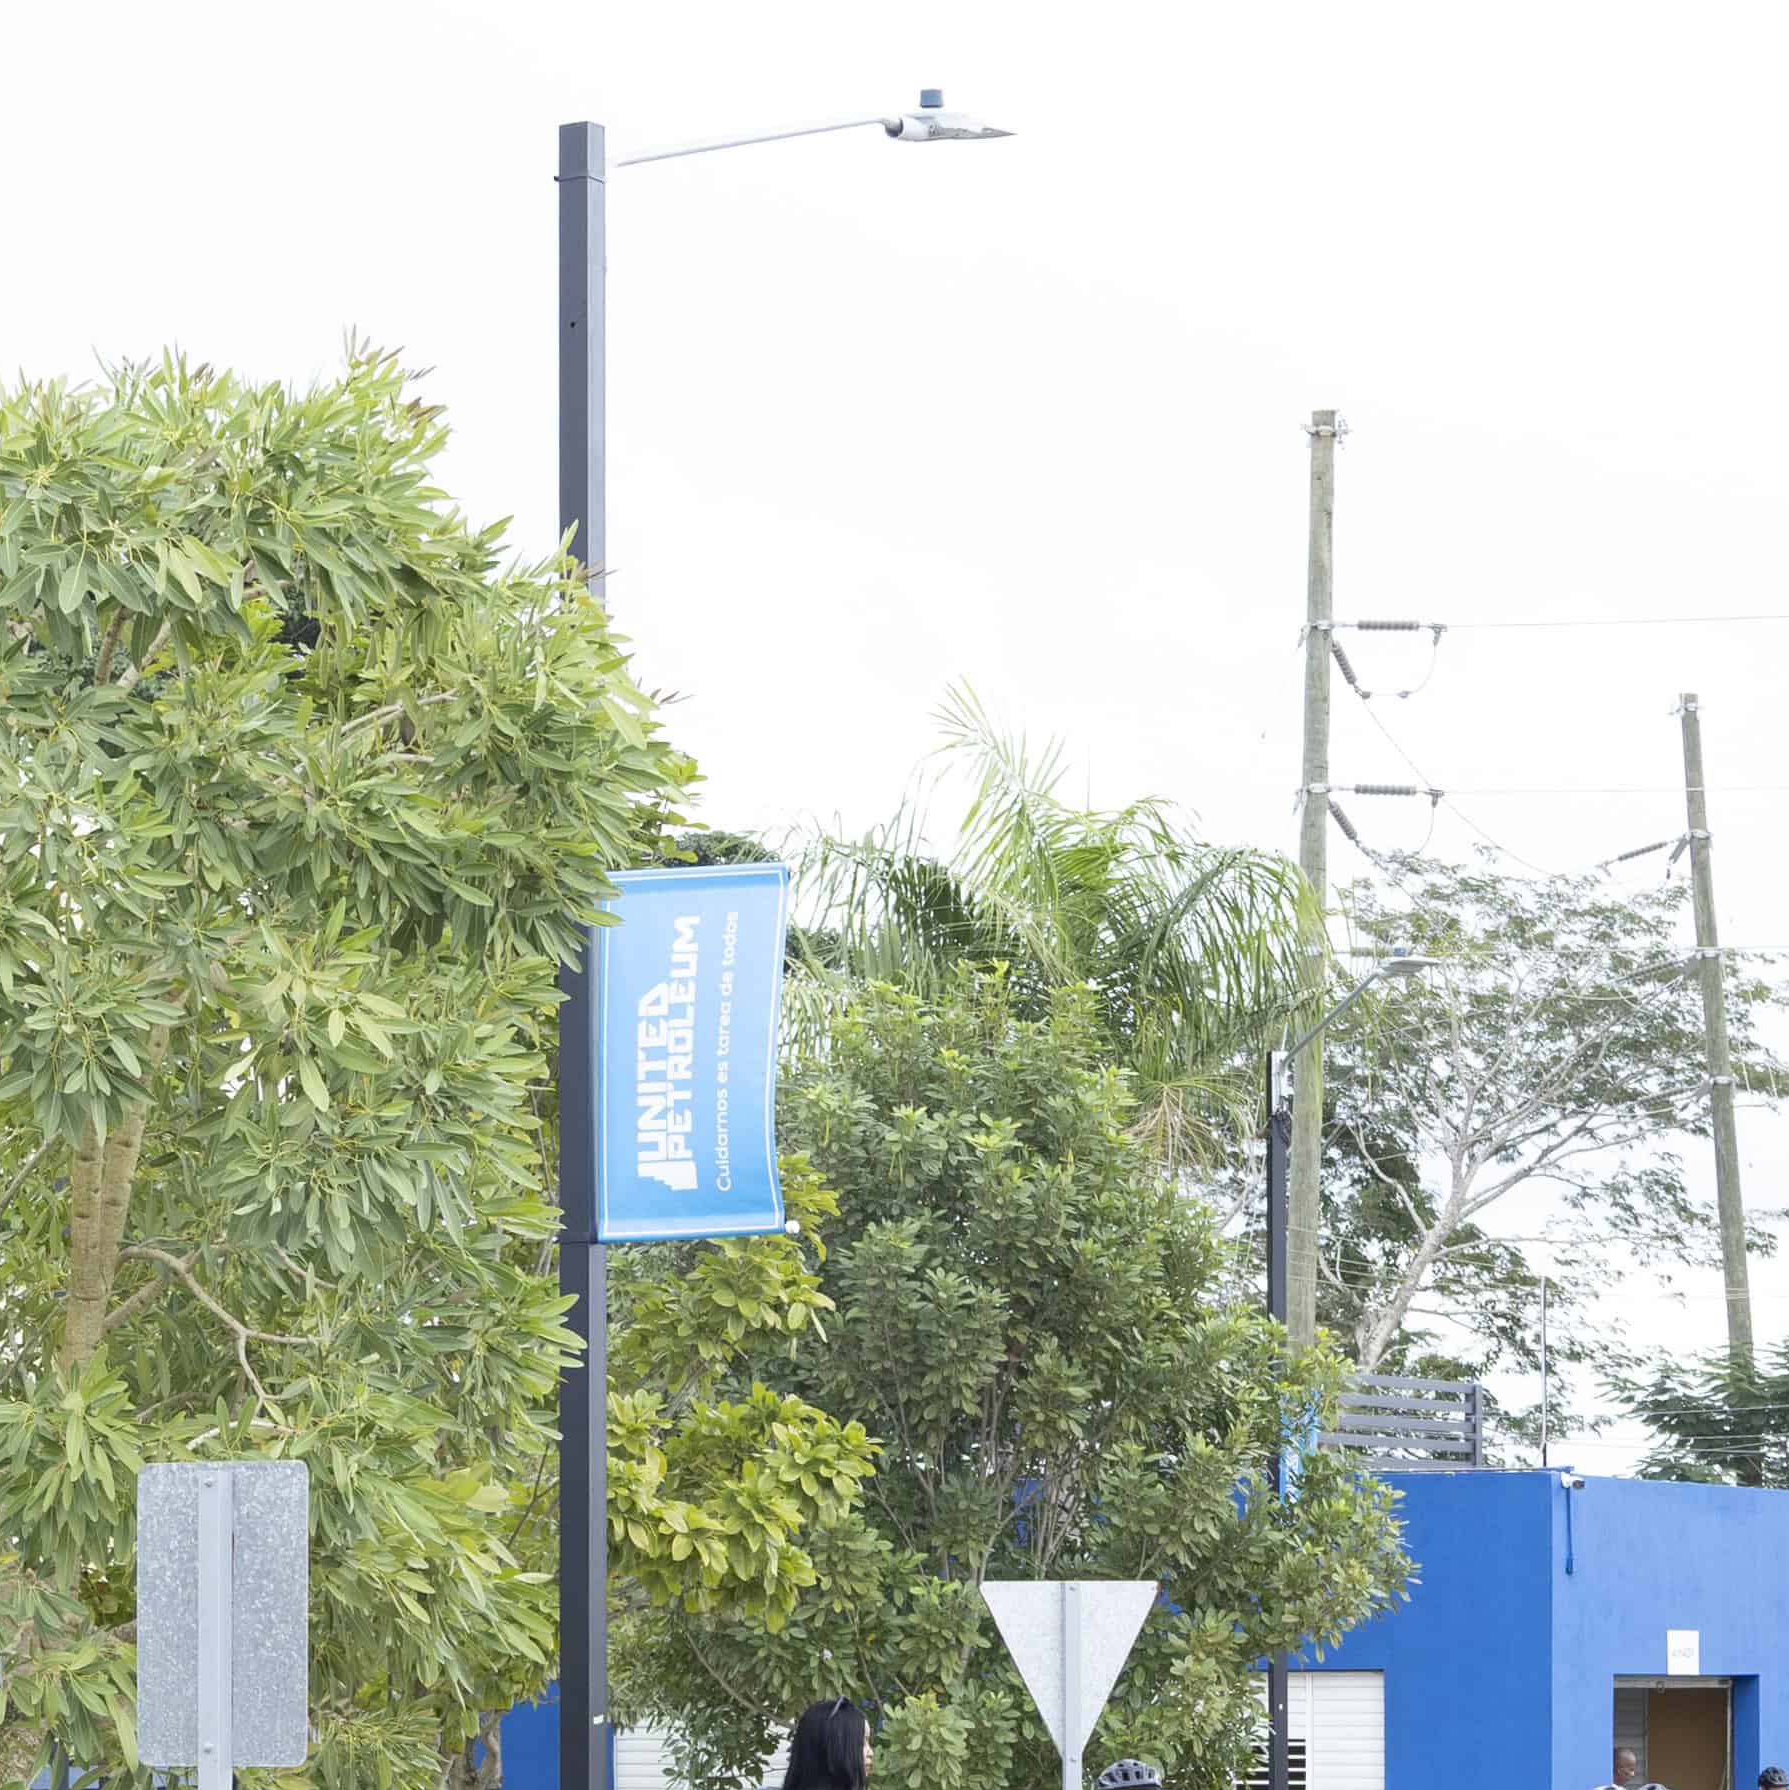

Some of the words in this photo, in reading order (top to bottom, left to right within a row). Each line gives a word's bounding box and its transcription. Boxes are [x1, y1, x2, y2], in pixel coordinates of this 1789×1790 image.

[722, 909, 739, 967] todos
[719, 971, 735, 997] de
[667, 916, 700, 1160] PETROLEUM
[717, 1001, 733, 1057] tarea
[637, 983, 669, 1162] UNITED
[717, 1061, 730, 1085] es
[715, 1087, 732, 1192] Cuidarnos
